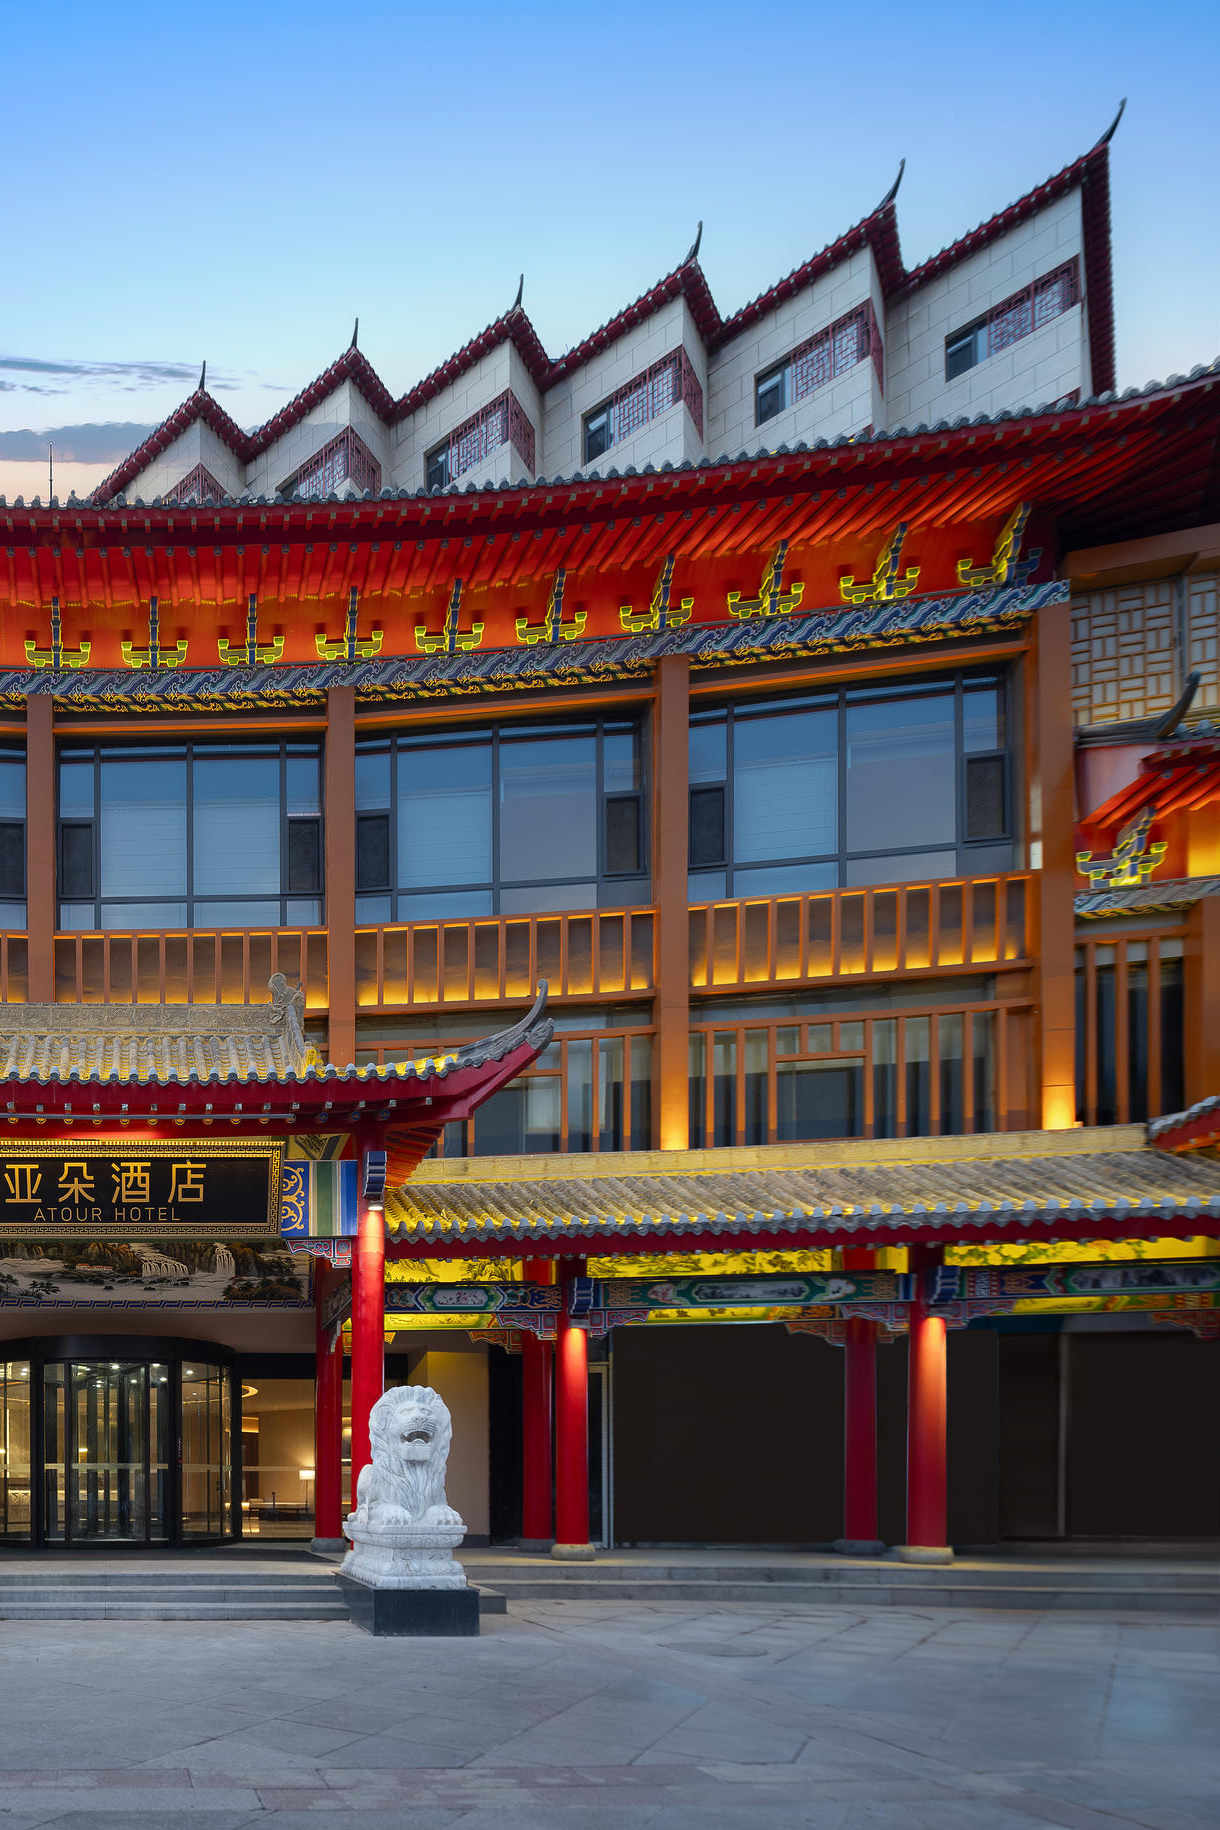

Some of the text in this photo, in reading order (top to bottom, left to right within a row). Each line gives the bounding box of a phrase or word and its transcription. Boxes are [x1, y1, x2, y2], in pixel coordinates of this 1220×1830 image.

[3, 1160, 207, 1204] 亚朵酒店
[34, 1207, 181, 1222] ATOUR HOTEL
